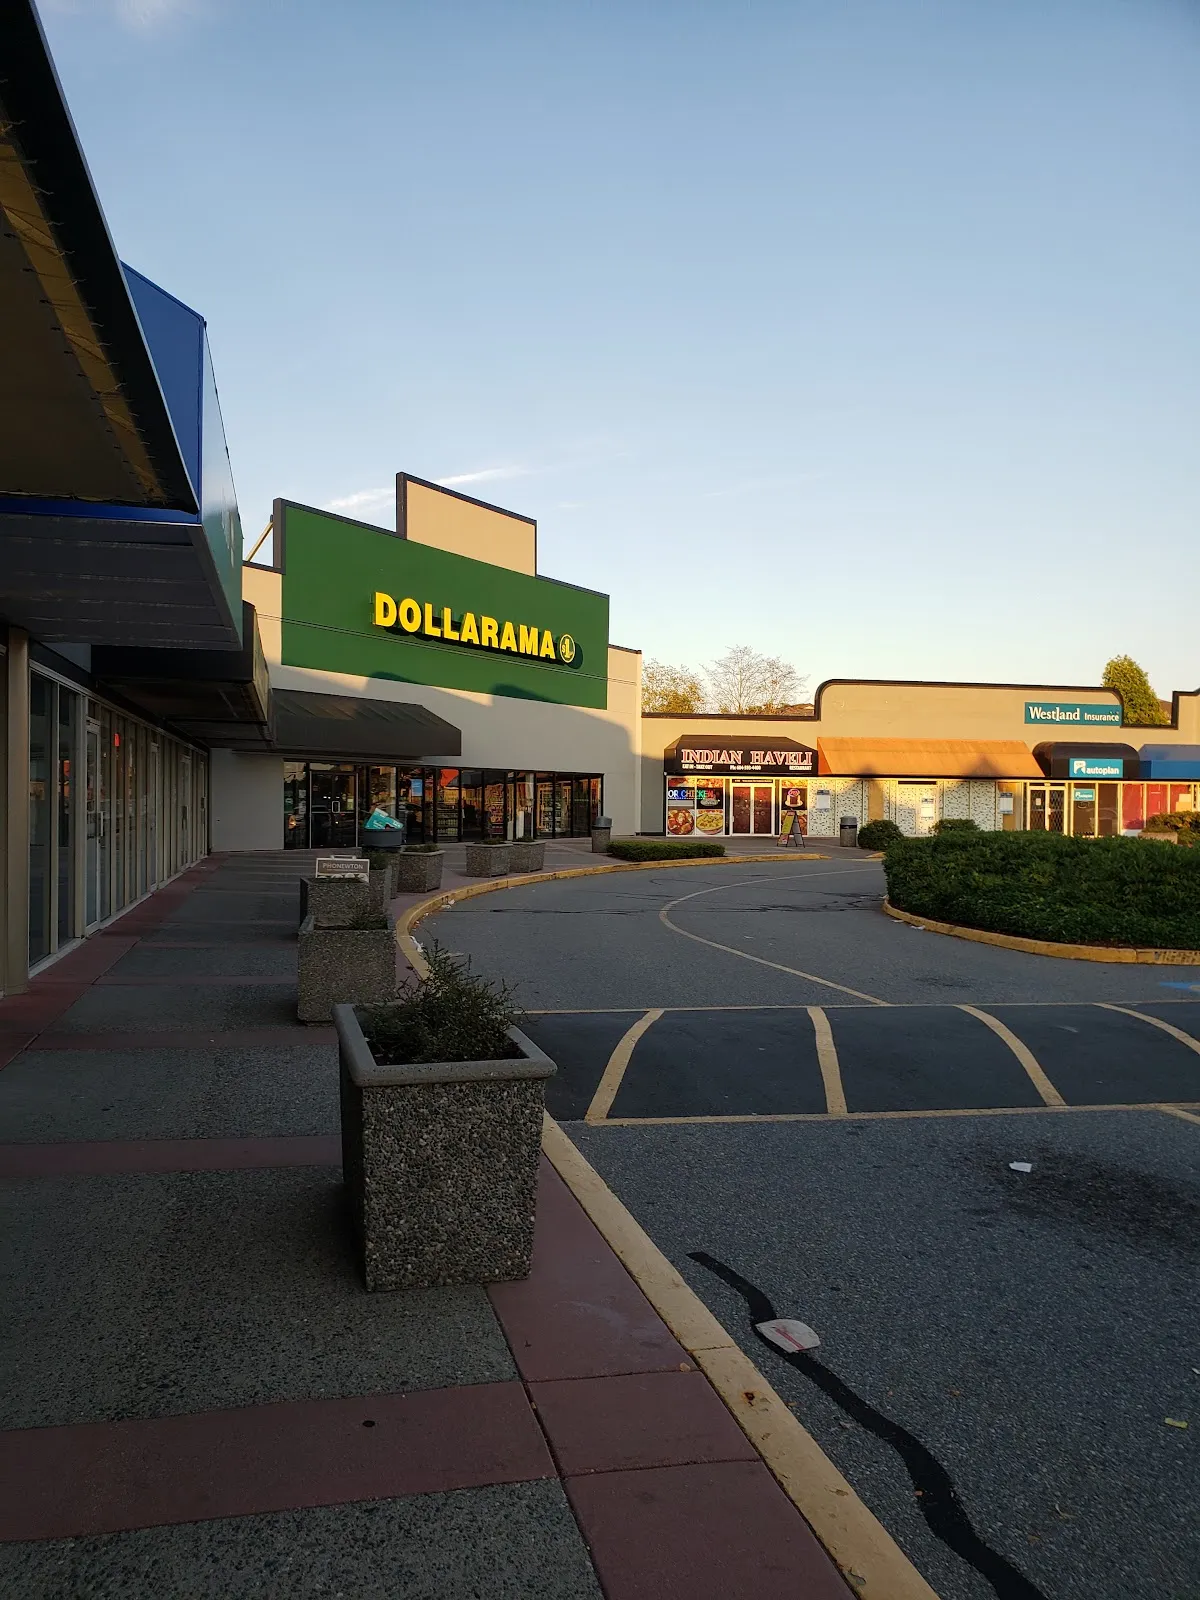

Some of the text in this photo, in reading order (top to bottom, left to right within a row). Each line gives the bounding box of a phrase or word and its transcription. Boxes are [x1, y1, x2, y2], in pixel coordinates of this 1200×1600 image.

[374, 591, 555, 659] DOLLARAMA
[1029, 706, 1119, 721] Westland Insurance
[681, 749, 813, 766] INDIAN HAVELI
[1086, 766, 1119, 775] autoplan
